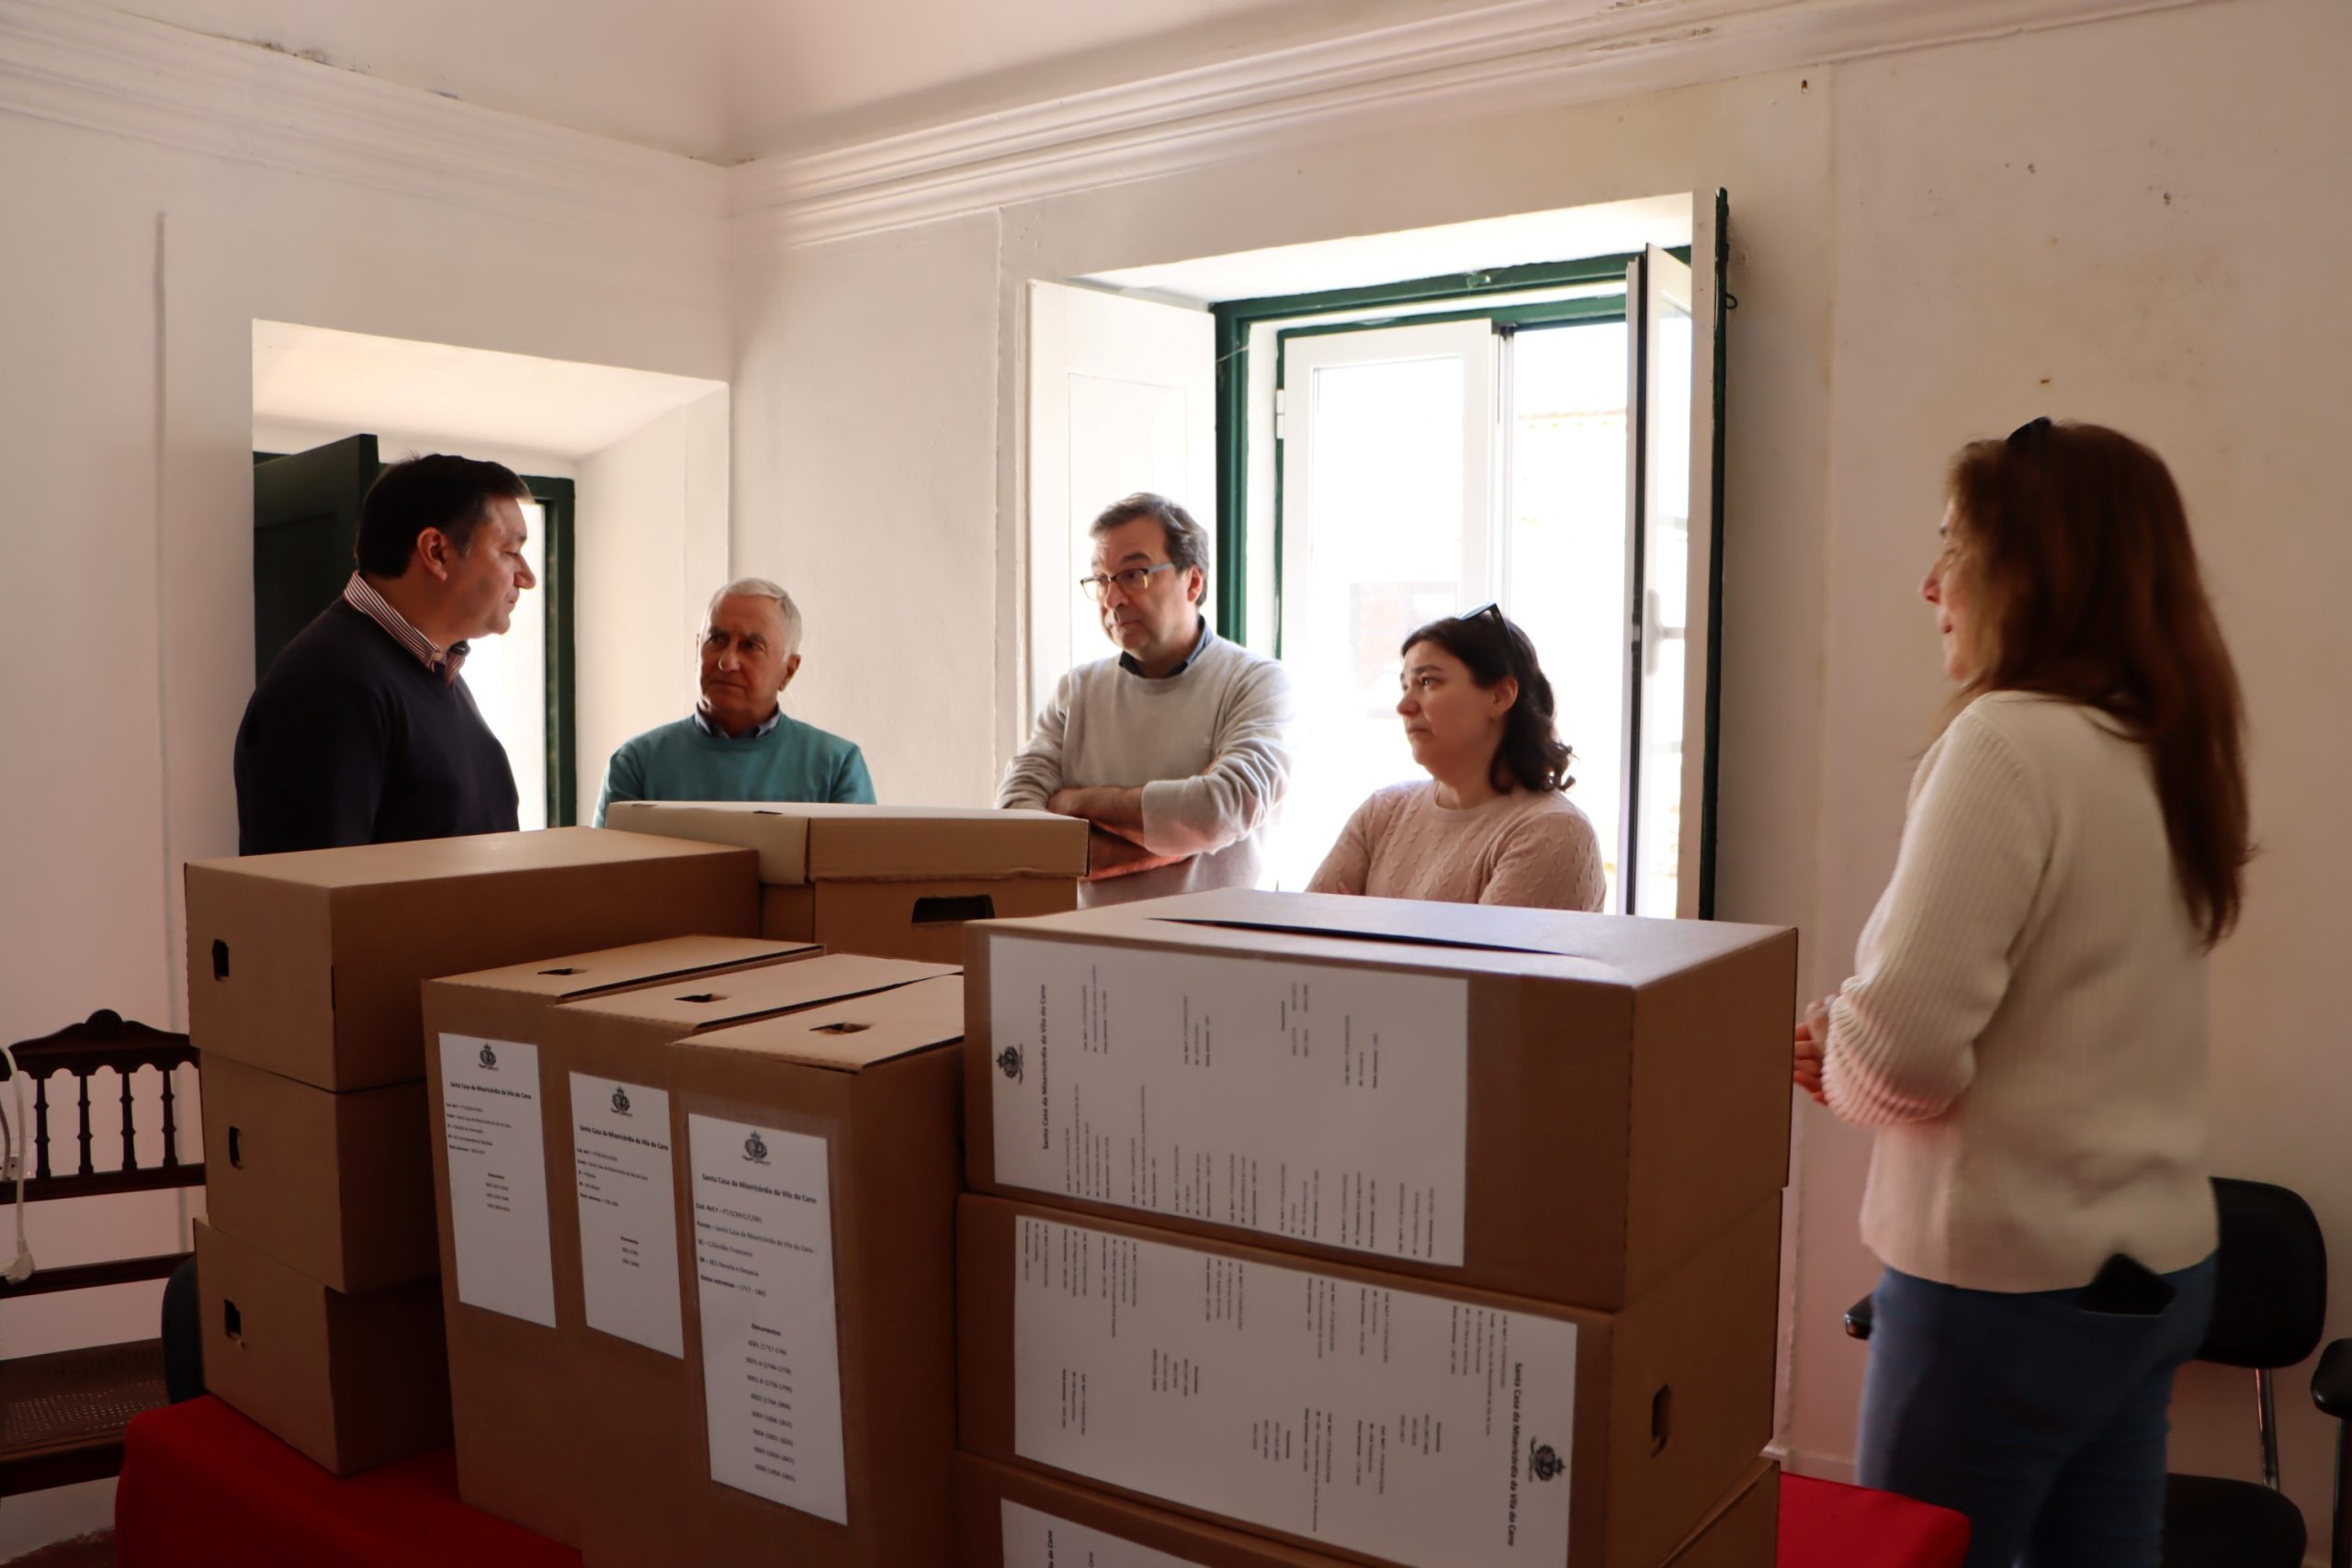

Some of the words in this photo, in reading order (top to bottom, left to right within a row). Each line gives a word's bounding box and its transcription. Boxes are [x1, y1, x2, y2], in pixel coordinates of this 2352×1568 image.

[703, 1173, 717, 1182] Santa
[718, 1177, 729, 1186] Casa
[782, 1190, 793, 1199] Vila
[802, 1194, 817, 1203] Cano
[1513, 1362, 1523, 1387] Santa
[1513, 1389, 1521, 1409] Casa
[1509, 1494, 1519, 1509] Vila
[1508, 1525, 1516, 1546] Cano
